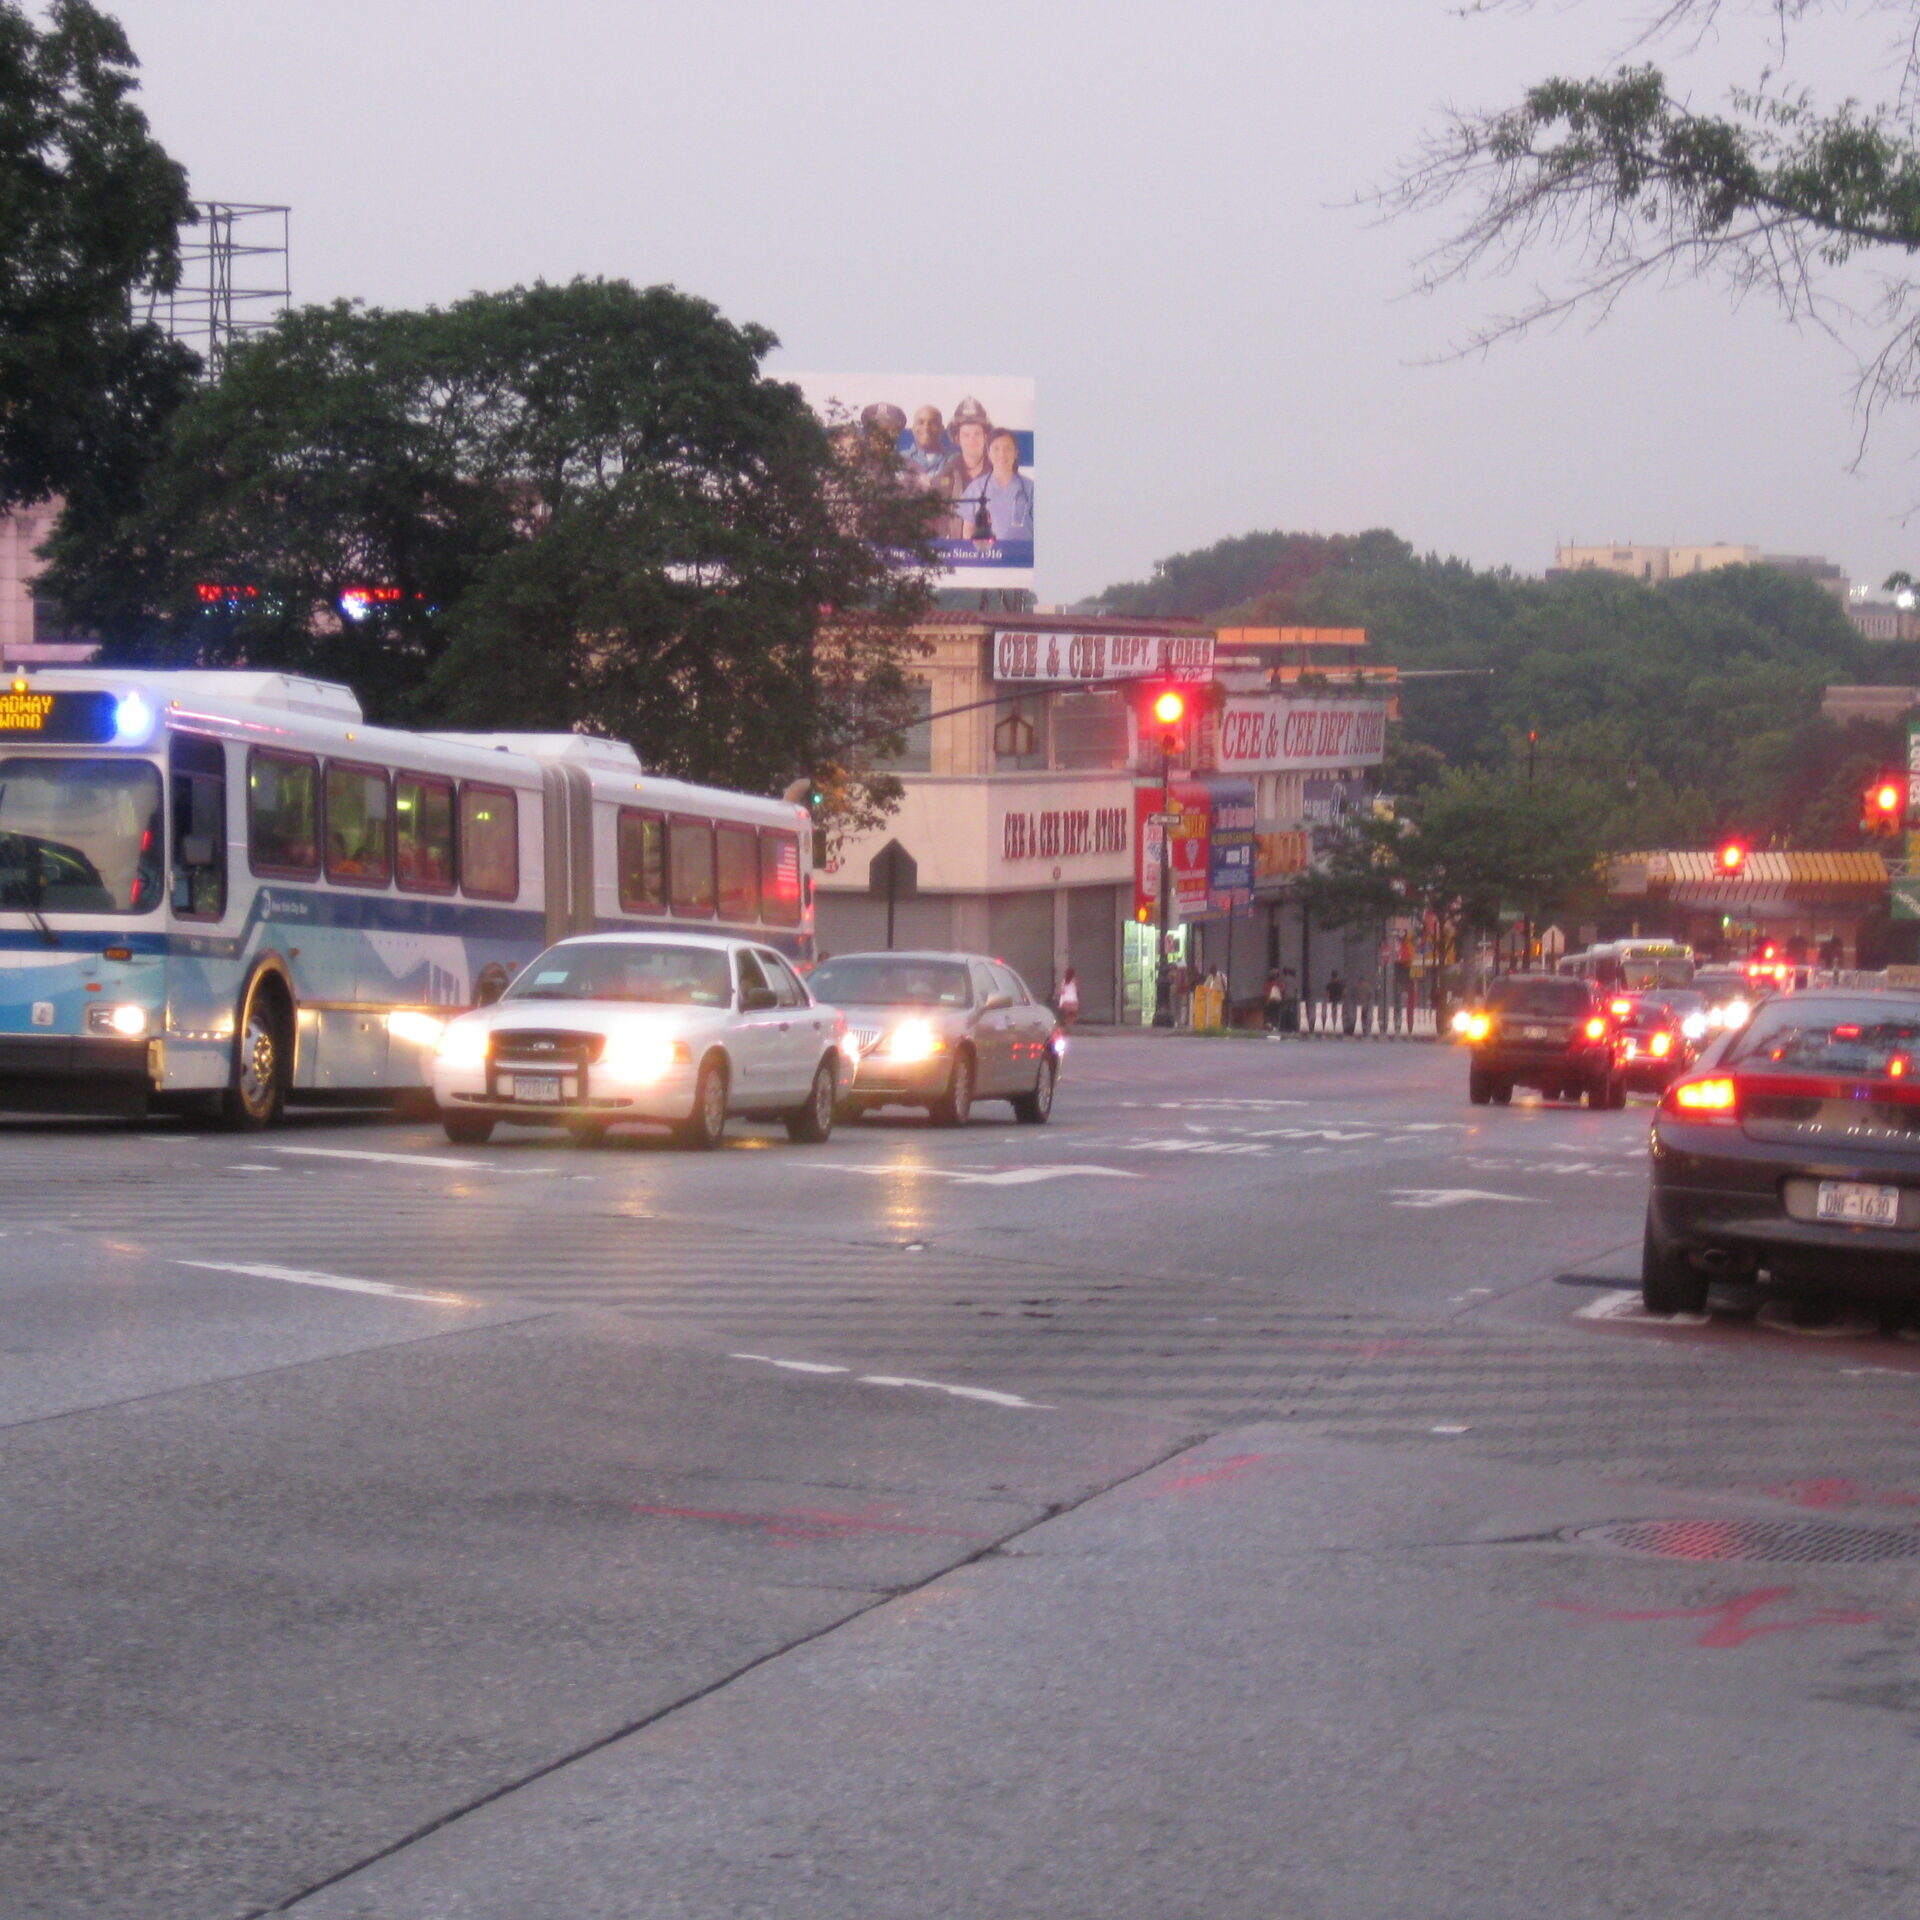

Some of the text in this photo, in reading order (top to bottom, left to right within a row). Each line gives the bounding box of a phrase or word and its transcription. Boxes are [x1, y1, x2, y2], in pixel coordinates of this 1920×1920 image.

[953, 547, 979, 560] Since
[980, 547, 1003, 560] 1916
[999, 633, 1211, 678] CEE & CEE DEPT. STORES
[1222, 710, 1266, 760] CEE
[1266, 712, 1279, 759] &
[1283, 710, 1318, 758] CEE
[1354, 710, 1384, 755] STORE
[1004, 812, 1025, 859] CEE
[1040, 811, 1060, 857] CEE
[1095, 807, 1127, 853] STORE
